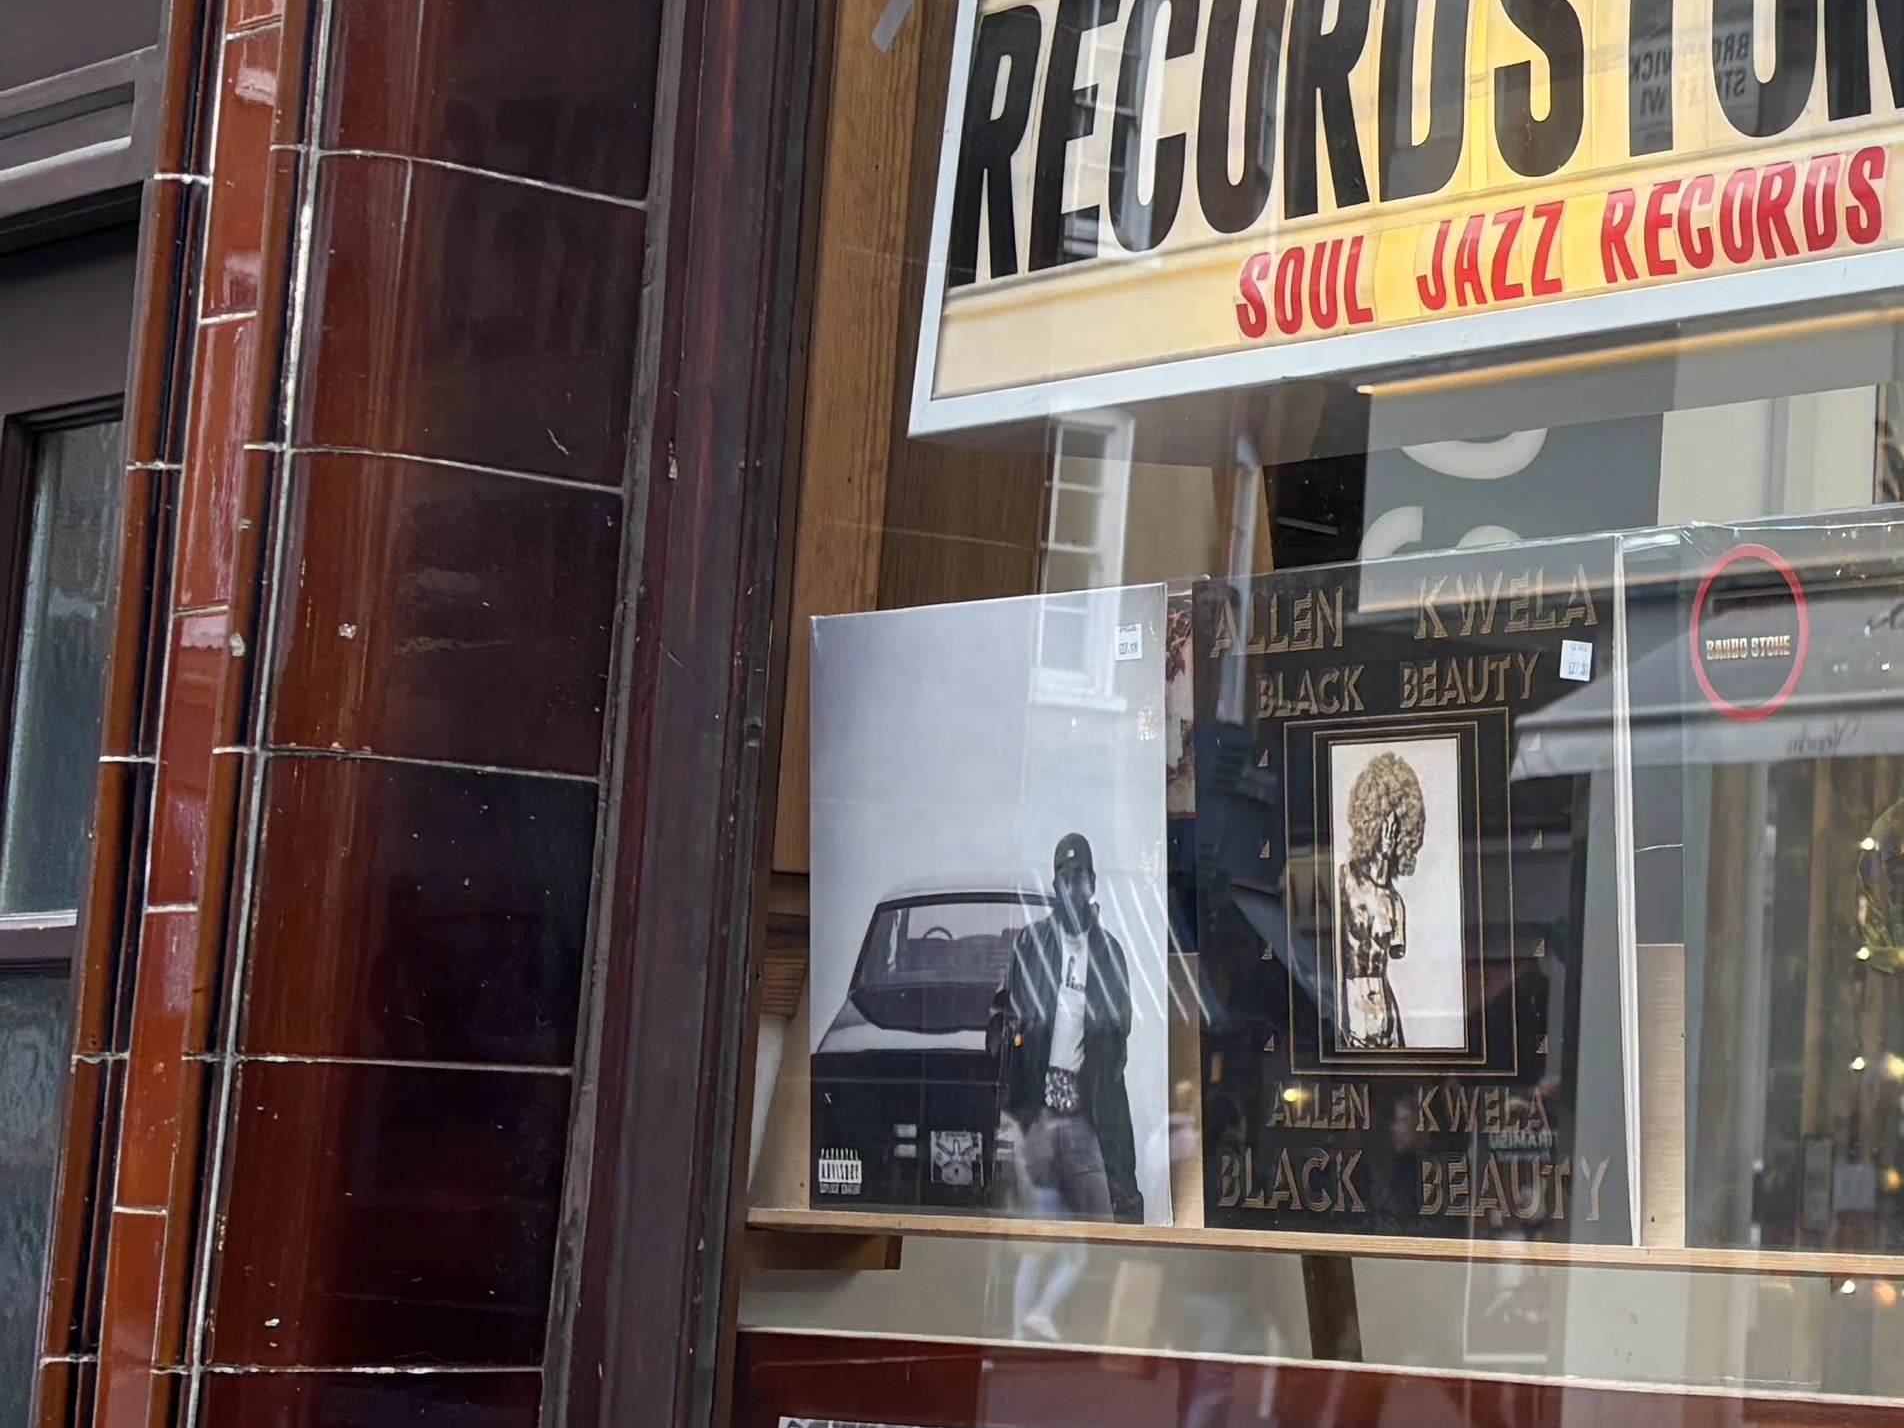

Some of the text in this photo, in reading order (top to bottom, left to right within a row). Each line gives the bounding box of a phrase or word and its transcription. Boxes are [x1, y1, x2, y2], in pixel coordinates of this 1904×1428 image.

[1236, 146, 1886, 338] SOUL JAZZ RECORDS
[1208, 585, 1343, 658] ALLEN
[1413, 563, 1598, 640] KWELA
[1705, 634, 1791, 661] BANDO STONE
[1256, 663, 1365, 720] BLACK
[1400, 649, 1544, 709] BEAUTY
[1265, 1081, 1552, 1135] ALLEN KWELA
[1217, 1147, 1610, 1222] BLACK BEAUTY
